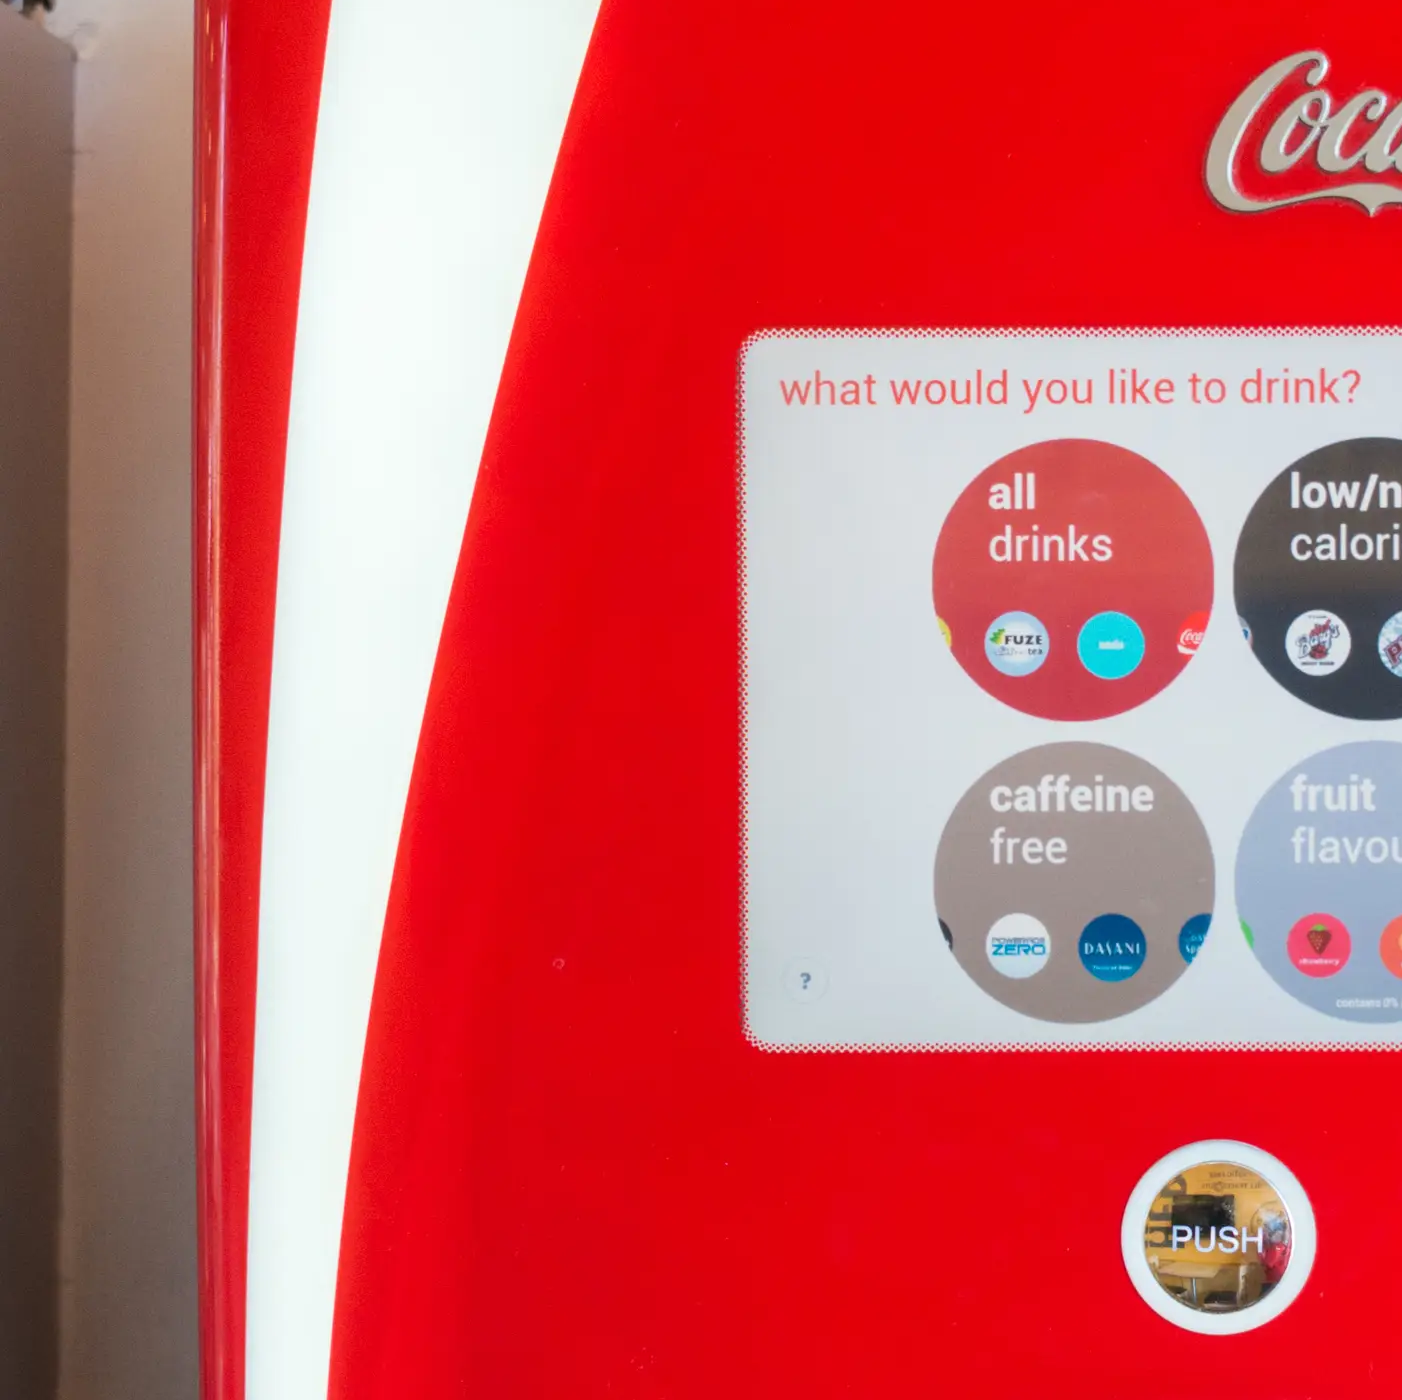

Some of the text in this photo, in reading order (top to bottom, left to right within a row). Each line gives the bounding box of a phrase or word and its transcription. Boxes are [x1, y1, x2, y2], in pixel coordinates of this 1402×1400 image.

[780, 368, 1362, 415] what would you like to drink?
[988, 472, 1036, 510] all
[988, 524, 1114, 562] drinks
[1004, 635, 1043, 645] FUZE
[989, 773, 1154, 813] caffeine
[1290, 773, 1376, 812] fruit
[989, 826, 1069, 865] free
[991, 943, 1047, 956] ZERO
[1084, 941, 1140, 956] DASANI
[1171, 1224, 1264, 1254] PUSH
